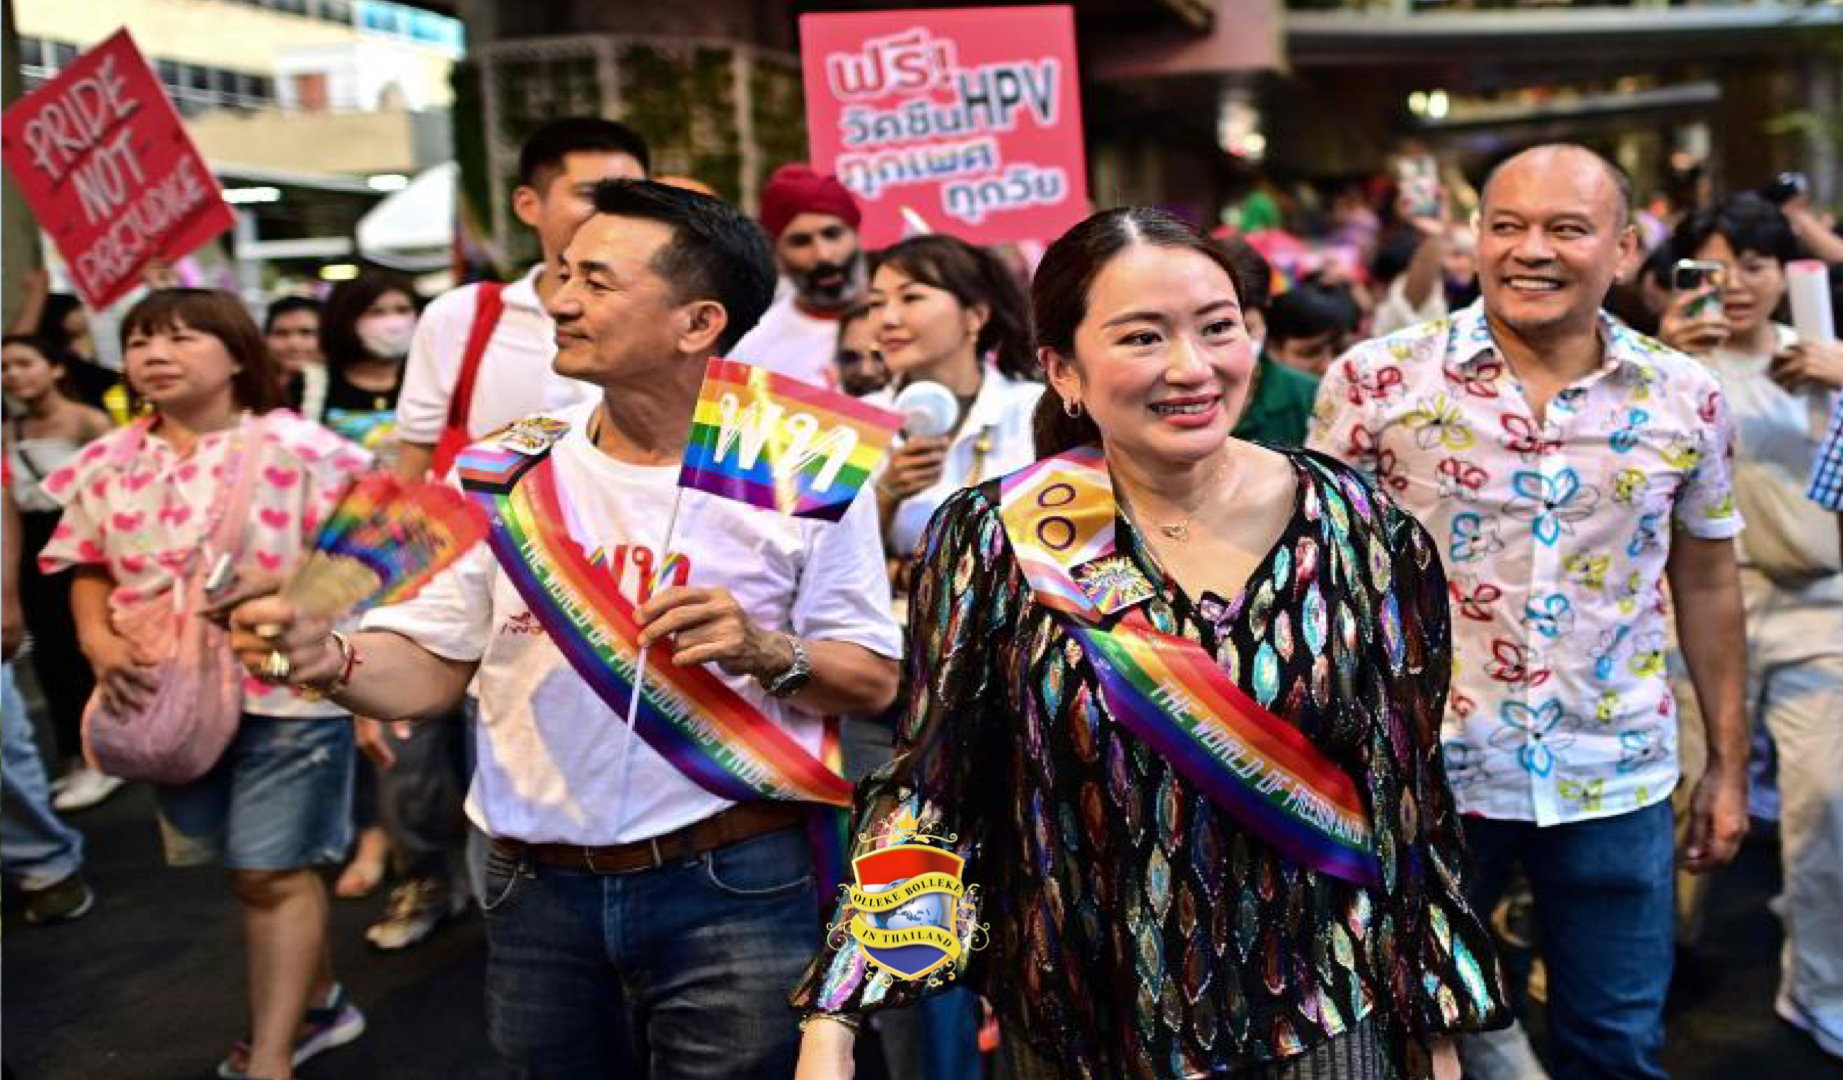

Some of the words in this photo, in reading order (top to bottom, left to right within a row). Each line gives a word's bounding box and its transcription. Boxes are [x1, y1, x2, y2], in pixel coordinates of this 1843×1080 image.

[24, 53, 138, 181] PRIDE
[959, 64, 1054, 130] HPV
[72, 127, 146, 223] NOT
[75, 155, 206, 293] PREJUDICE
[520, 535, 547, 575] THE
[586, 621, 616, 648] OF
[1149, 678, 1191, 723] THE
[1189, 716, 1261, 779] WORLD
[1254, 766, 1291, 794] OF
